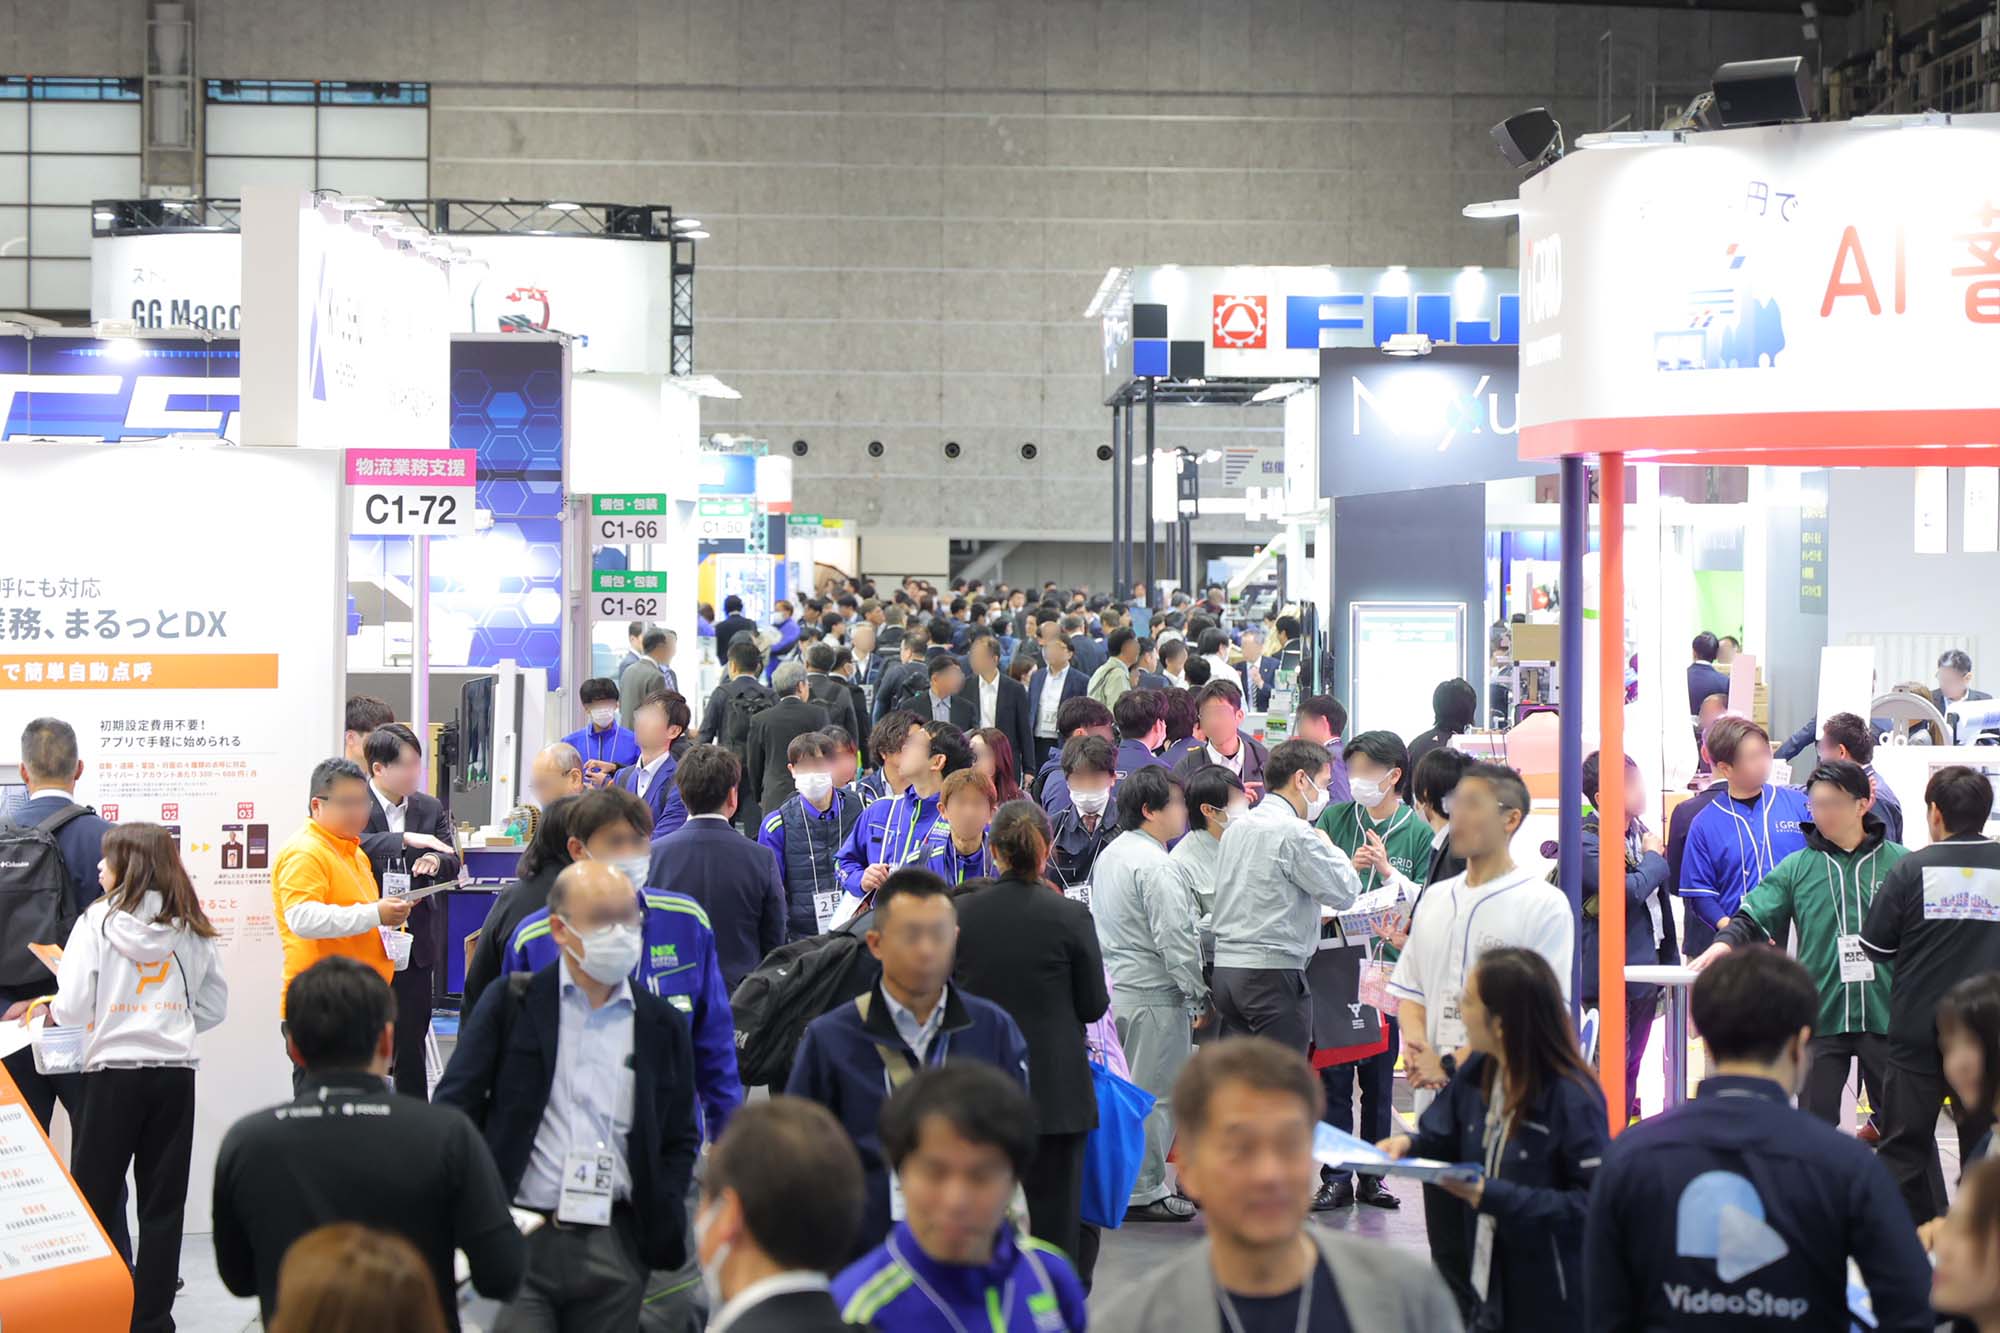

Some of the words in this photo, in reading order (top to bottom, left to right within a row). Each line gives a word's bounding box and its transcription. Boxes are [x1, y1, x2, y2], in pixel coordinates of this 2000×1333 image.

[1820, 225, 1906, 318] AI
[132, 299, 162, 329] GG
[356, 458, 465, 477] 物流業務支援
[366, 494, 456, 524] C1-72
[601, 520, 658, 538] C1-66
[601, 597, 657, 615] C1-62
[0, 607, 227, 641] 務、まるっとDX
[3, 661, 153, 682] で簡単自動点呼
[100, 736, 242, 748] アプリで手軽に始められる
[103, 811, 117, 821] 01
[163, 810, 177, 820] 02
[238, 808, 252, 819] 03
[820, 901, 829, 912] 2
[574, 1164, 587, 1183] 4
[1663, 1282, 1809, 1320] VideoStep
